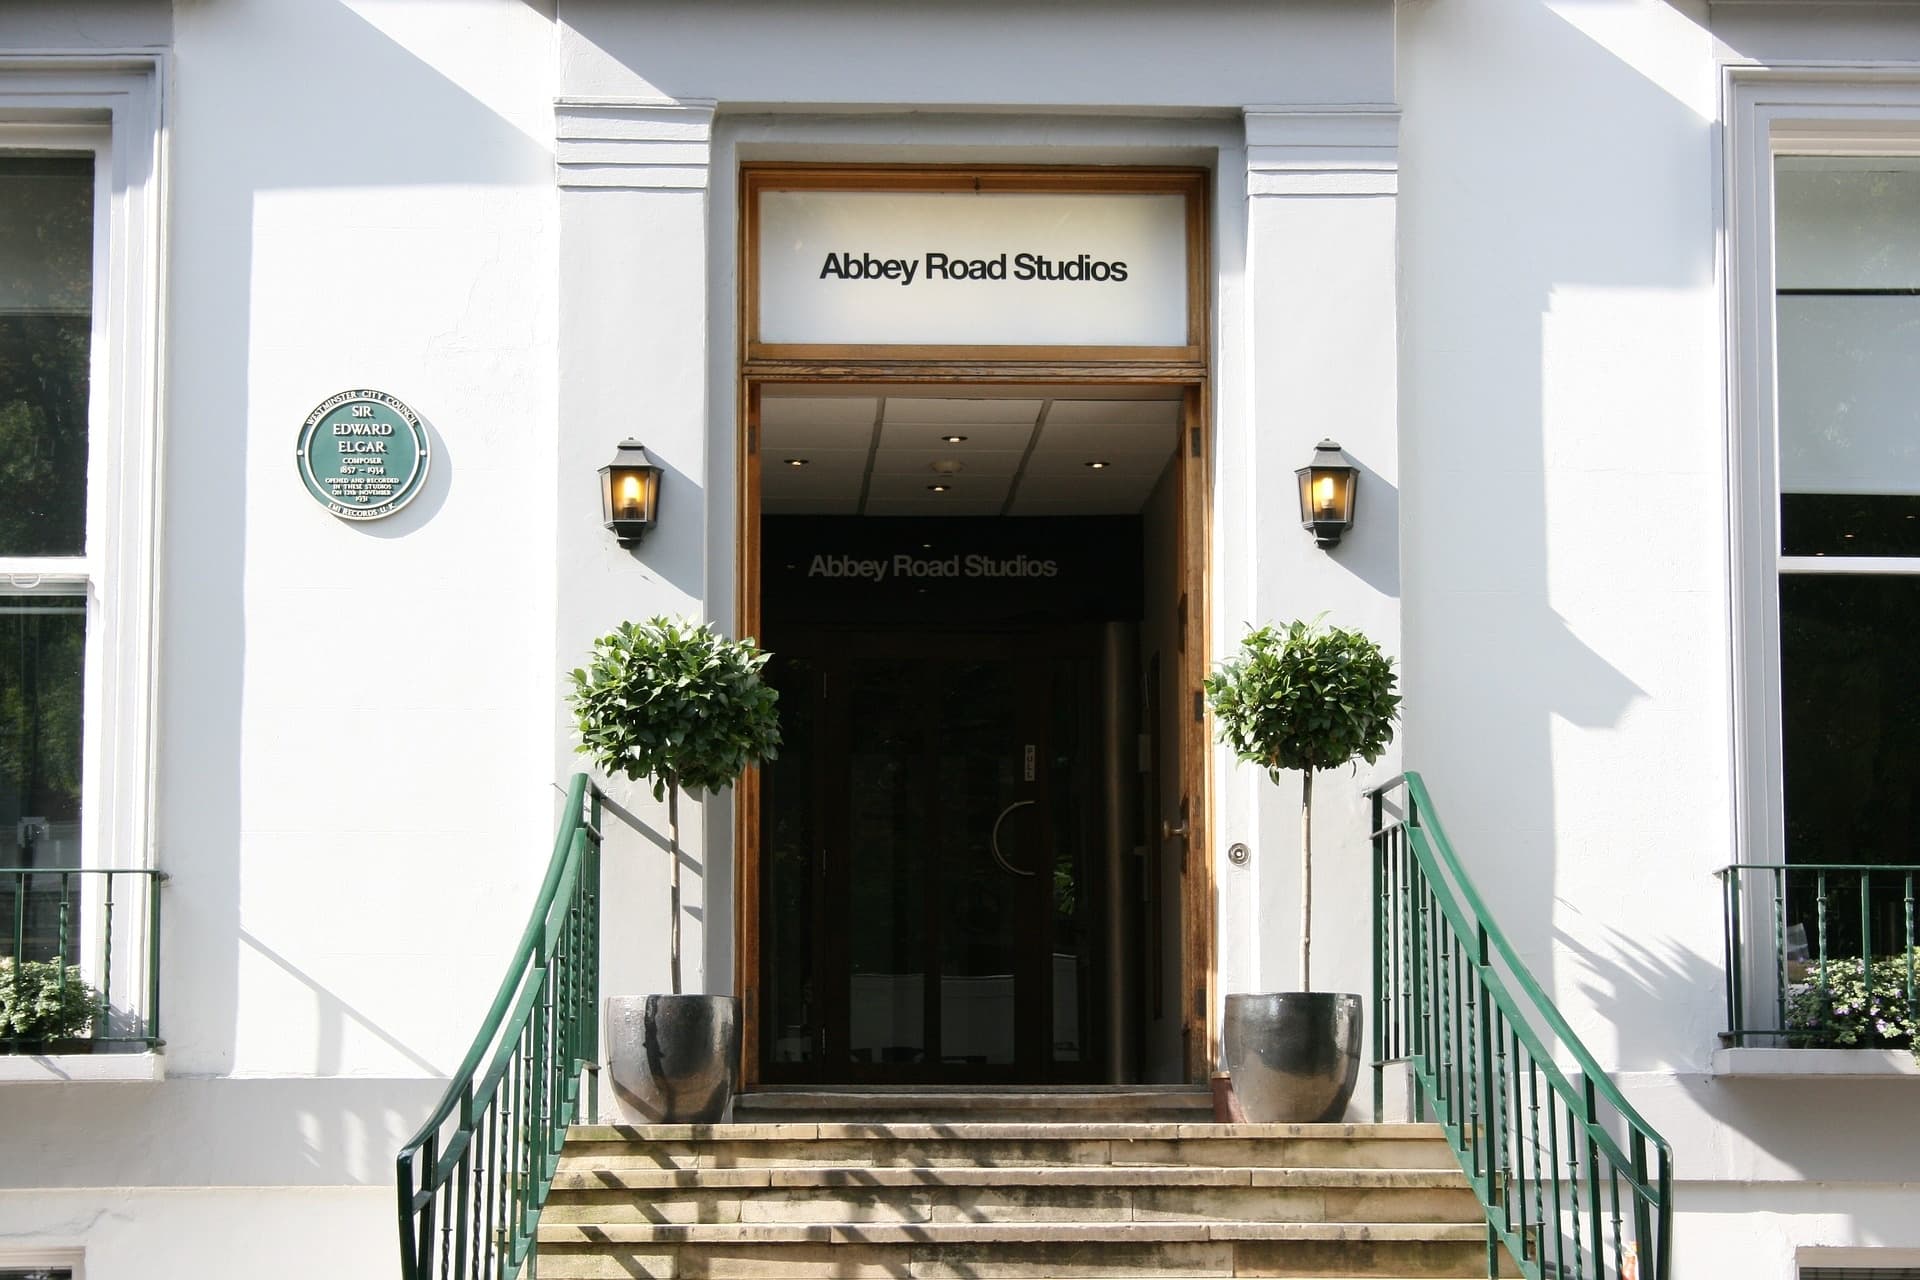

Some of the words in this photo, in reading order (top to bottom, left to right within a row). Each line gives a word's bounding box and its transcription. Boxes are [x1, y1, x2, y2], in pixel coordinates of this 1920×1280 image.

[819, 252, 919, 286] Abbey
[925, 252, 1007, 281] Road
[1013, 252, 1128, 282] Studios
[306, 391, 357, 426] WESTMINSTER
[361, 390, 384, 400] CITY
[386, 395, 418, 427] COUNCIL
[351, 405, 373, 417] SIR
[332, 423, 393, 435] EDWARD
[338, 441, 386, 453] ELGAR
[340, 466, 356, 474] 1857
[367, 466, 384, 475] 1934
[327, 502, 341, 512] EMI
[342, 508, 378, 518] RECORDS
[808, 554, 889, 583] Abbey
[893, 554, 960, 577] Road
[964, 554, 1059, 577] Studios
